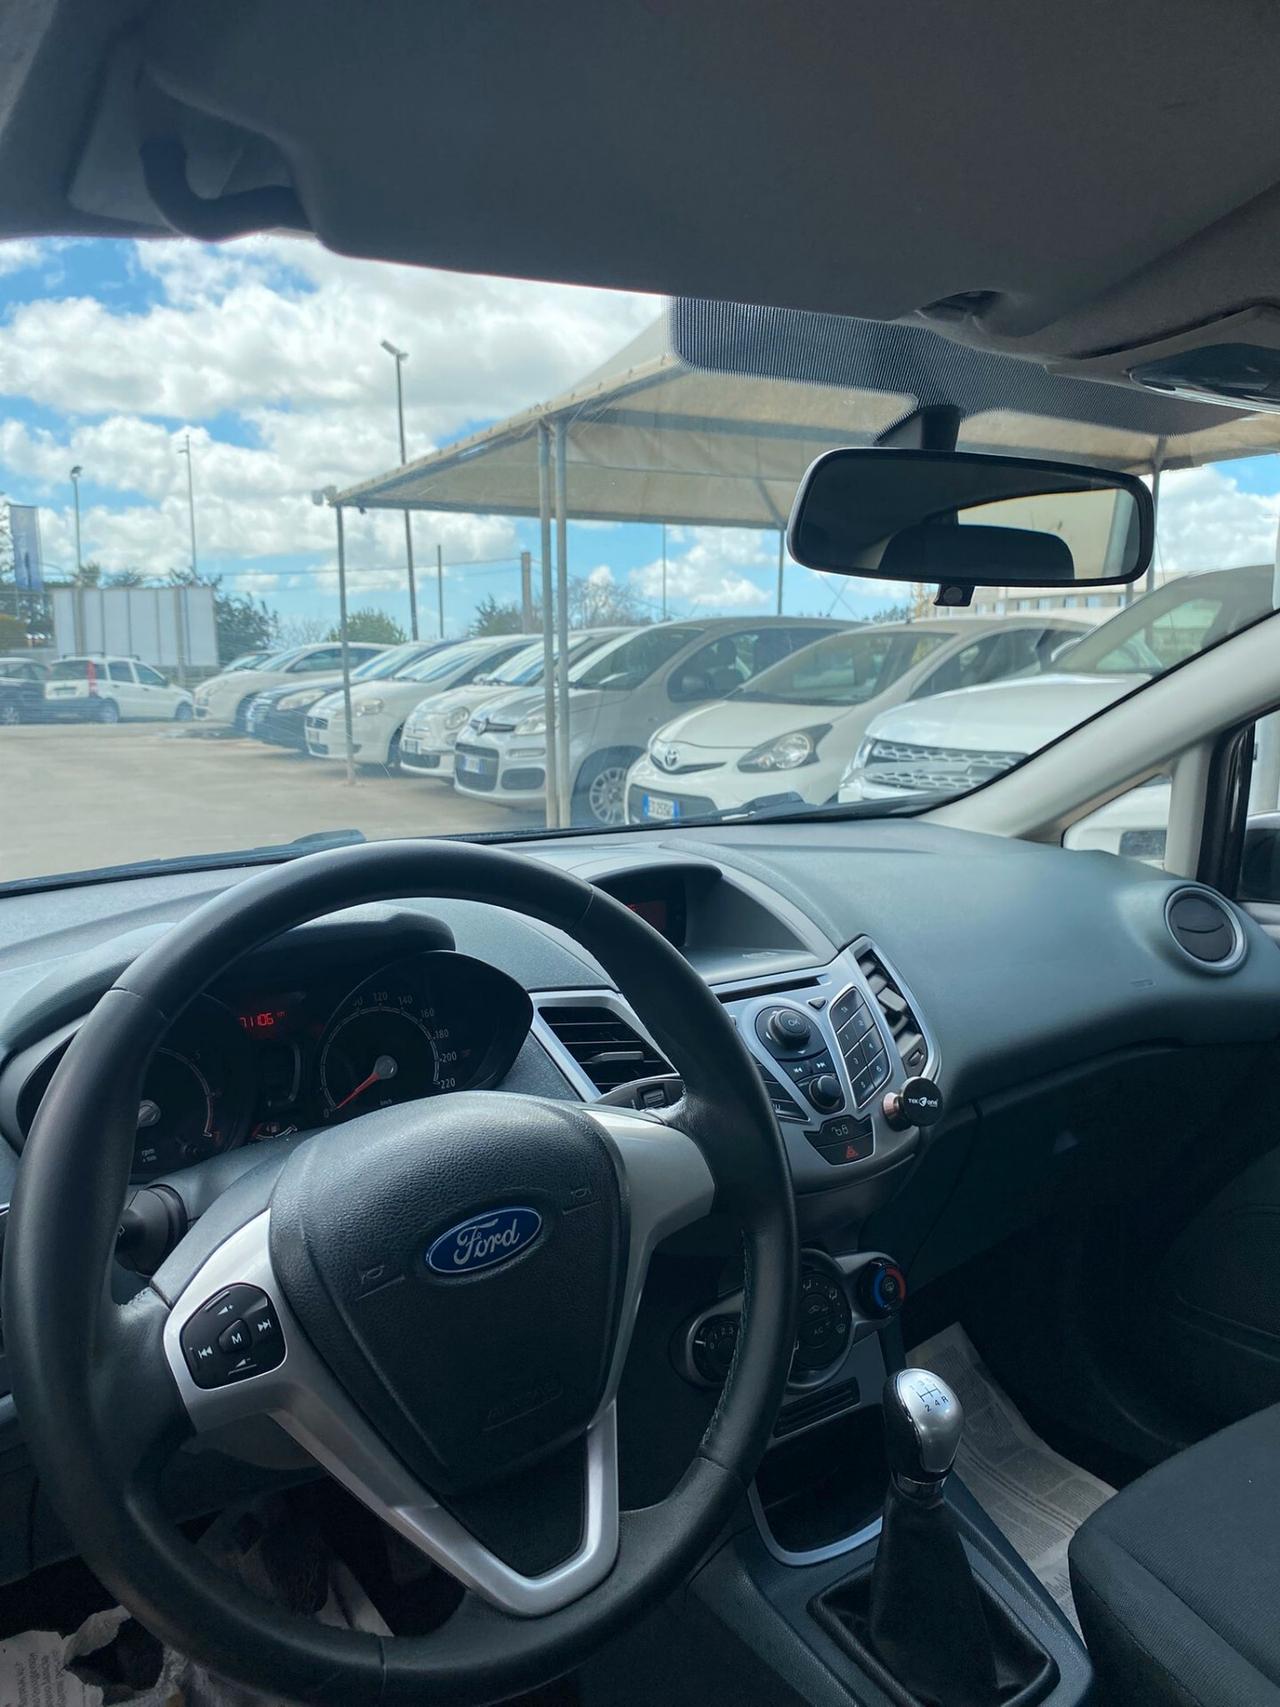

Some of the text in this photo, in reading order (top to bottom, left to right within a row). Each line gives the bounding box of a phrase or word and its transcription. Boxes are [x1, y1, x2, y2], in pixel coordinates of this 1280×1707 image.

[372, 992, 388, 1002] 120
[397, 995, 413, 1006] 140
[419, 1008, 435, 1018] 160
[434, 1029, 449, 1039] 180
[441, 1051, 457, 1063] 200
[440, 1077, 456, 1089] 220
[453, 1218, 520, 1265] Ford
[231, 1332, 242, 1344] M
[941, 1395, 949, 1403] R
[925, 1404, 931, 1412] 2
